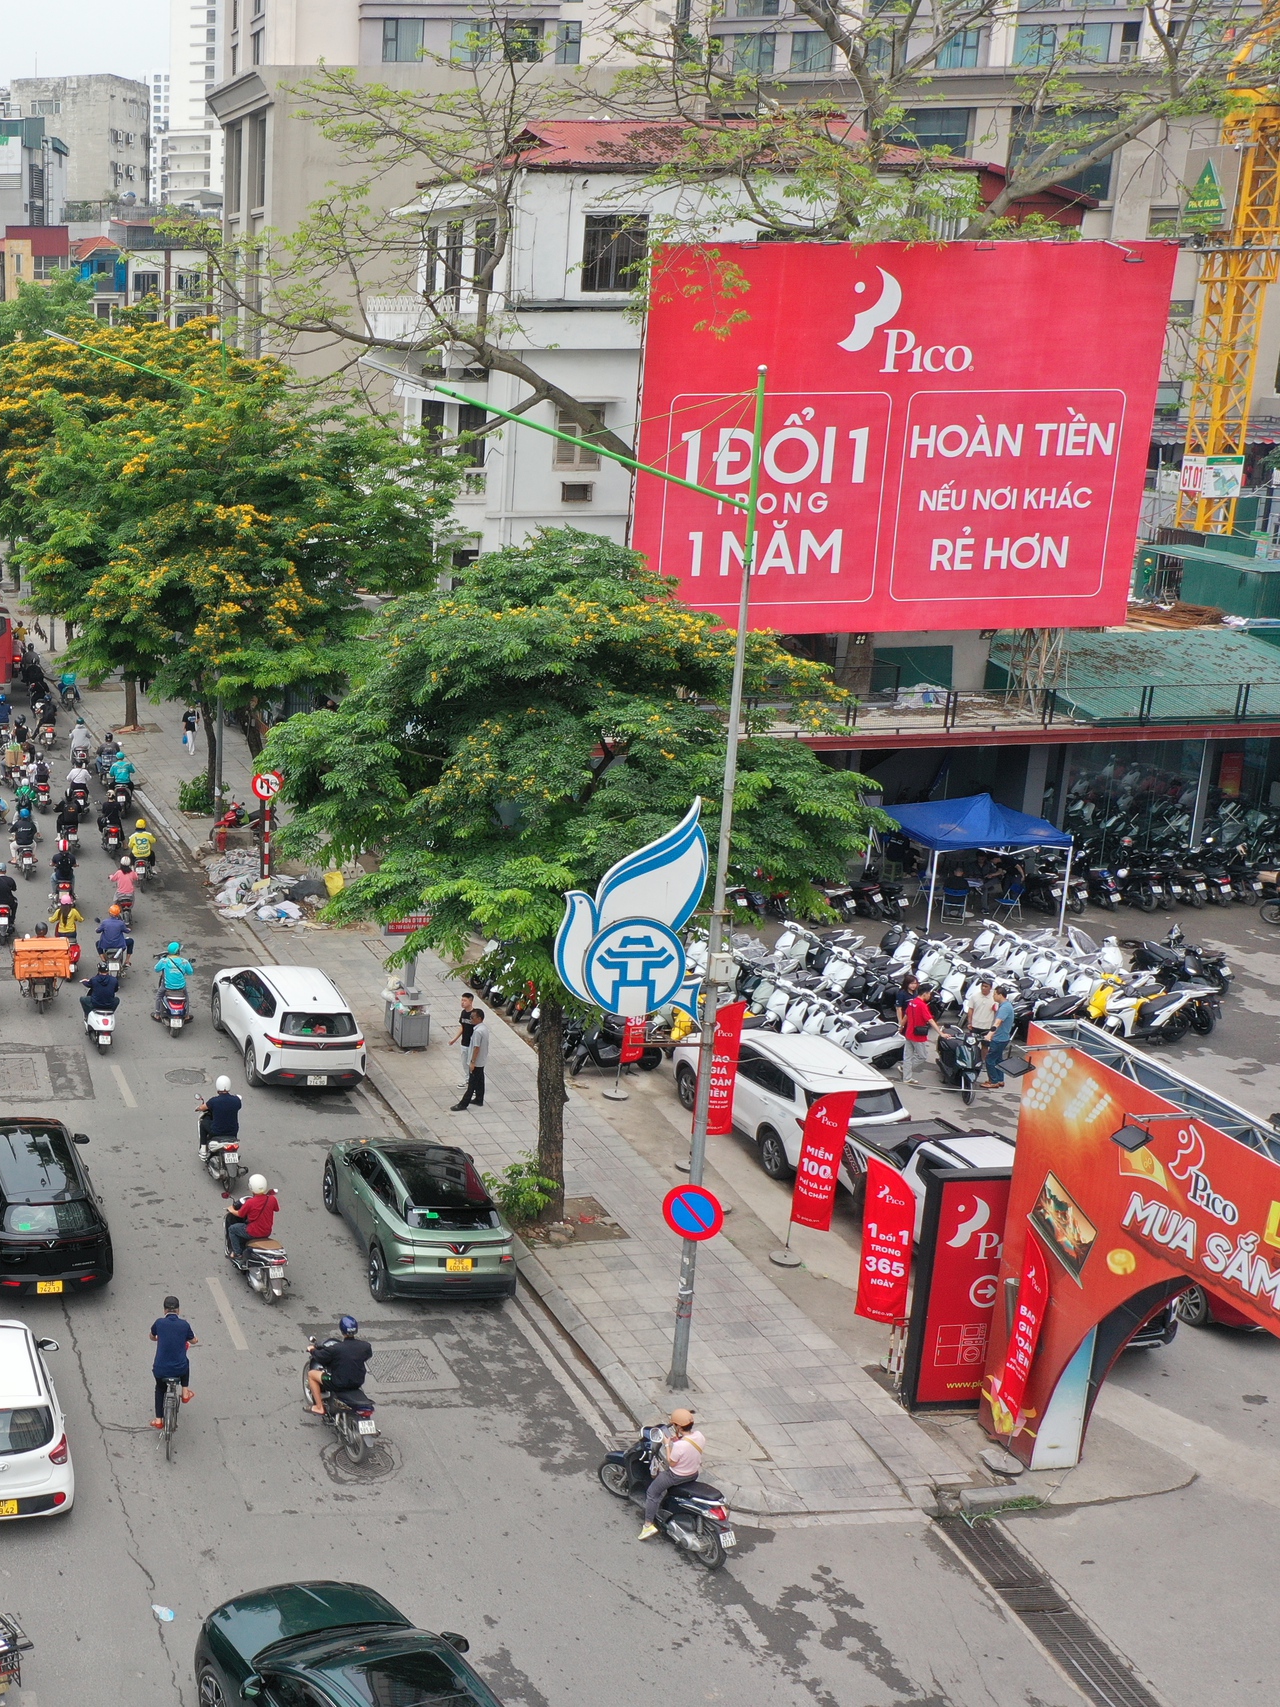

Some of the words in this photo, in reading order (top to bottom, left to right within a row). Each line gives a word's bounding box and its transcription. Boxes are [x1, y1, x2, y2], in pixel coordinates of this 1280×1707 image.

[909, 414, 1022, 459] HOÀN
[1036, 406, 1116, 457] TIỀN
[681, 429, 703, 487] 1
[848, 427, 869, 484] 1
[1182, 466, 1192, 488] CT
[1193, 466, 1204, 488] 01
[918, 480, 967, 513] NẾU
[972, 486, 1020, 511] NƠI
[1023, 481, 1092, 510] KHÁC
[688, 531, 703, 577] 1
[719, 519, 844, 577] NĂM
[929, 526, 974, 572] RẺ
[984, 532, 1069, 571] HƠN
[710, 1078, 732, 1086] OÀN
[806, 1145, 834, 1161] MIỄN
[868, 1222, 878, 1238] 1
[898, 1230, 909, 1246] 1
[870, 1244, 901, 1257] TRONG
[1122, 1192, 1197, 1262] MUA
[1202, 1232, 1280, 1310] SẮM
[865, 1256, 905, 1277] 365
[870, 1278, 894, 1288] NGÀY
